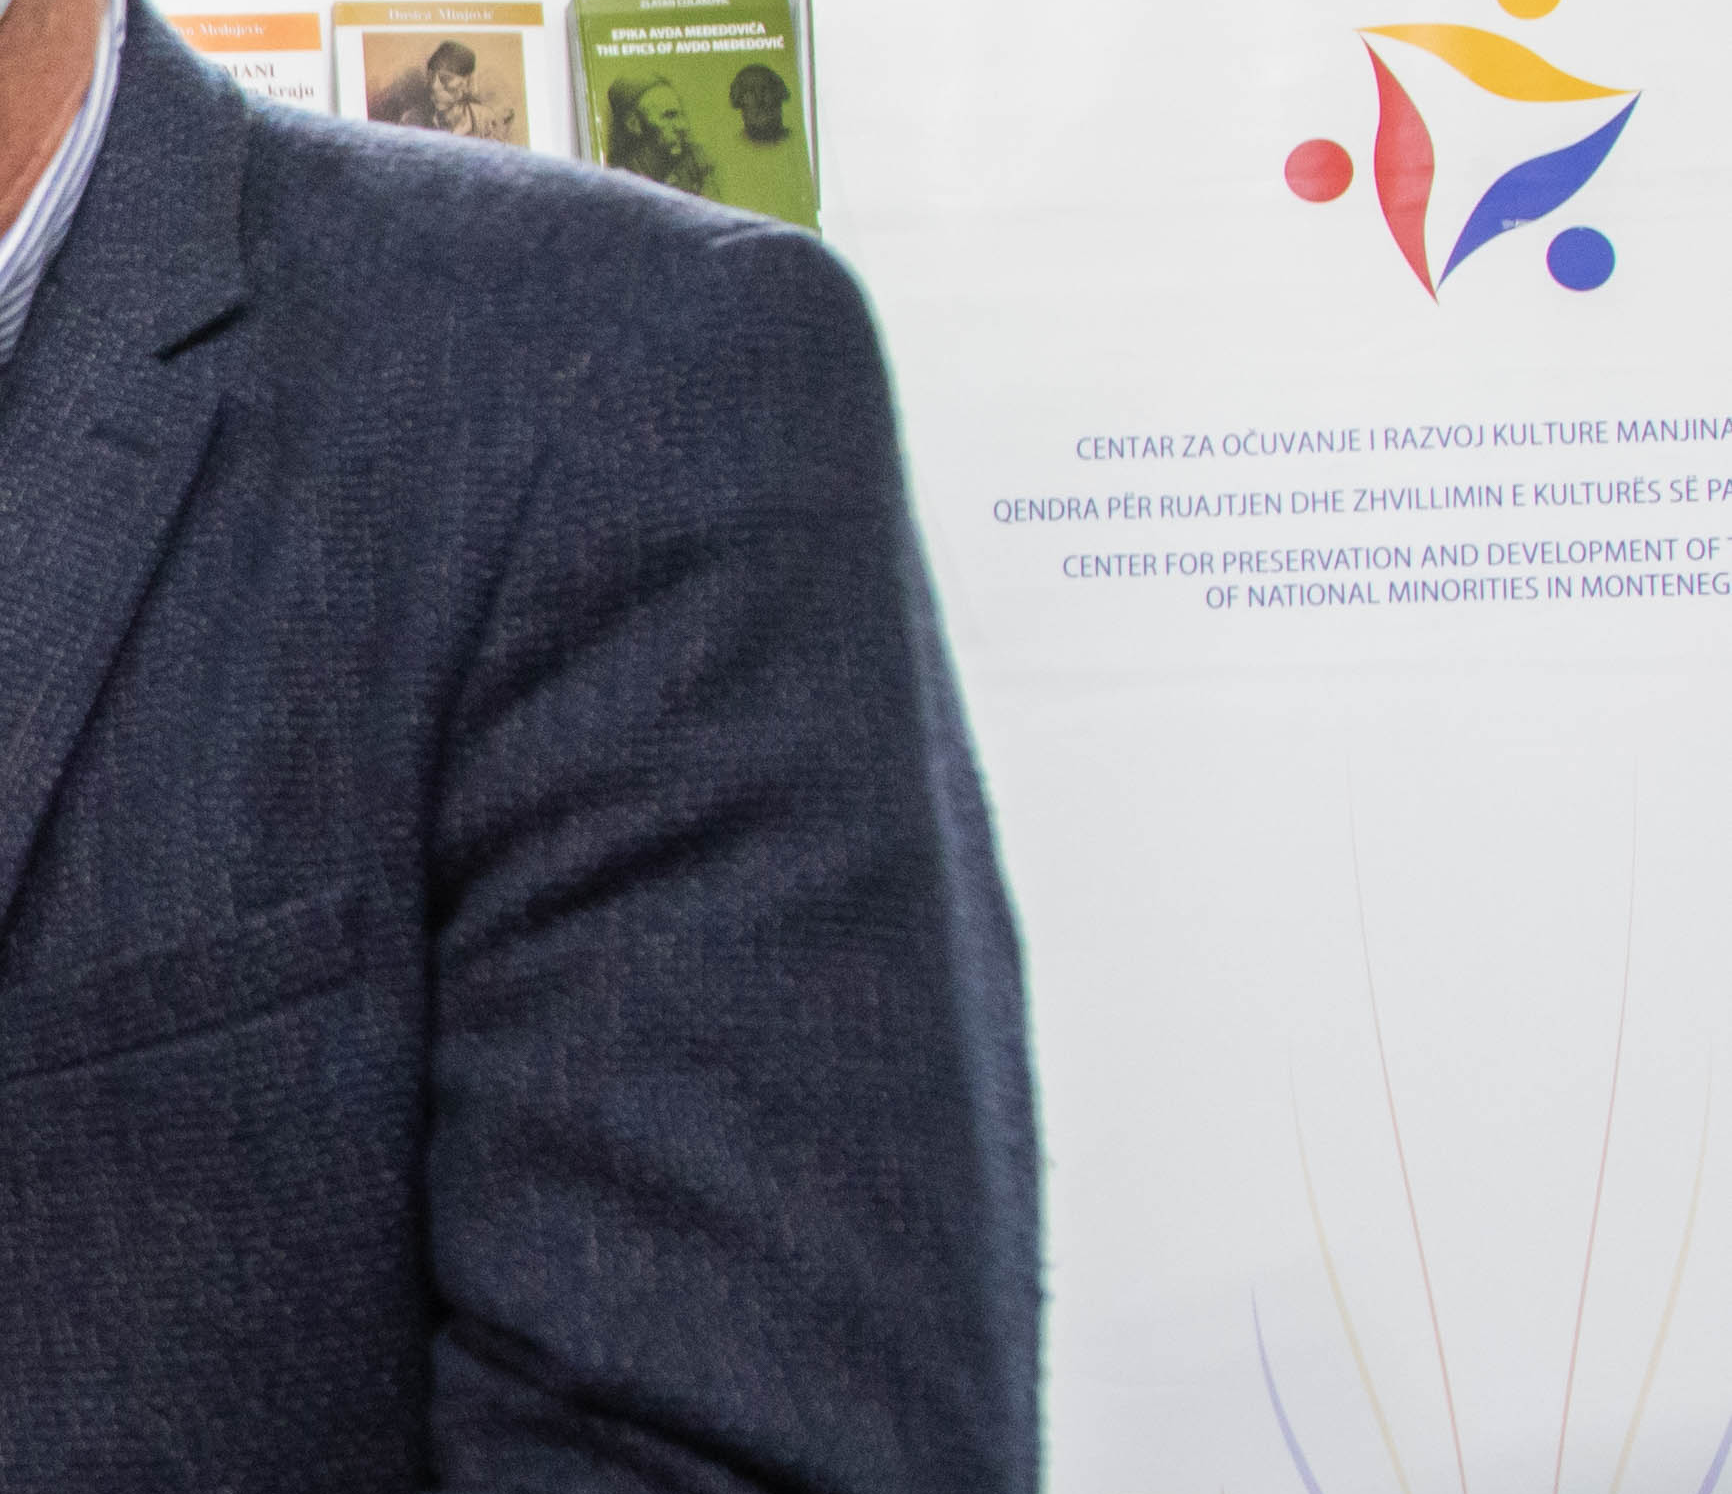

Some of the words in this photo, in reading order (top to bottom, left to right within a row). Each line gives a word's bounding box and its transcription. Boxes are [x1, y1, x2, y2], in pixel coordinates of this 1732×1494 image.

[596, 44, 619, 56] THE
[622, 42, 656, 55] EPICS
[658, 41, 674, 54] OF
[676, 40, 711, 53] AVDO
[611, 28, 647, 41] EPIKA
[650, 26, 683, 39] AVDA
[1076, 435, 1175, 460] CENTAR
[1182, 433, 1215, 458] ZA
[1222, 427, 1362, 456] OČUVANJE
[1384, 423, 1485, 450] RAZVOJ
[1493, 419, 1609, 447] KULTURE
[993, 497, 1100, 525] QENDRA
[1108, 491, 1152, 519] PËR
[1160, 492, 1282, 519] RUAJTJEN
[1291, 489, 1345, 515] DHE
[1353, 483, 1503, 513] ZHVILLIMIN
[1513, 483, 1526, 507] E
[1534, 477, 1662, 506] KULTURËS
[1670, 475, 1699, 503] SË
[1063, 552, 1158, 578] CENTER
[1165, 551, 1215, 577] FOR
[1223, 545, 1412, 573] PRESERVATION
[1421, 542, 1479, 568] AND
[1487, 538, 1679, 566] DEVELOPMENT
[1686, 536, 1721, 562] OF
[1205, 584, 1239, 610] OF
[1248, 579, 1380, 607] NATIONAL
[1388, 576, 1539, 603] MINORITIES
[1547, 575, 1573, 598] IN
[1581, 571, 1731, 598] MONTENEG
